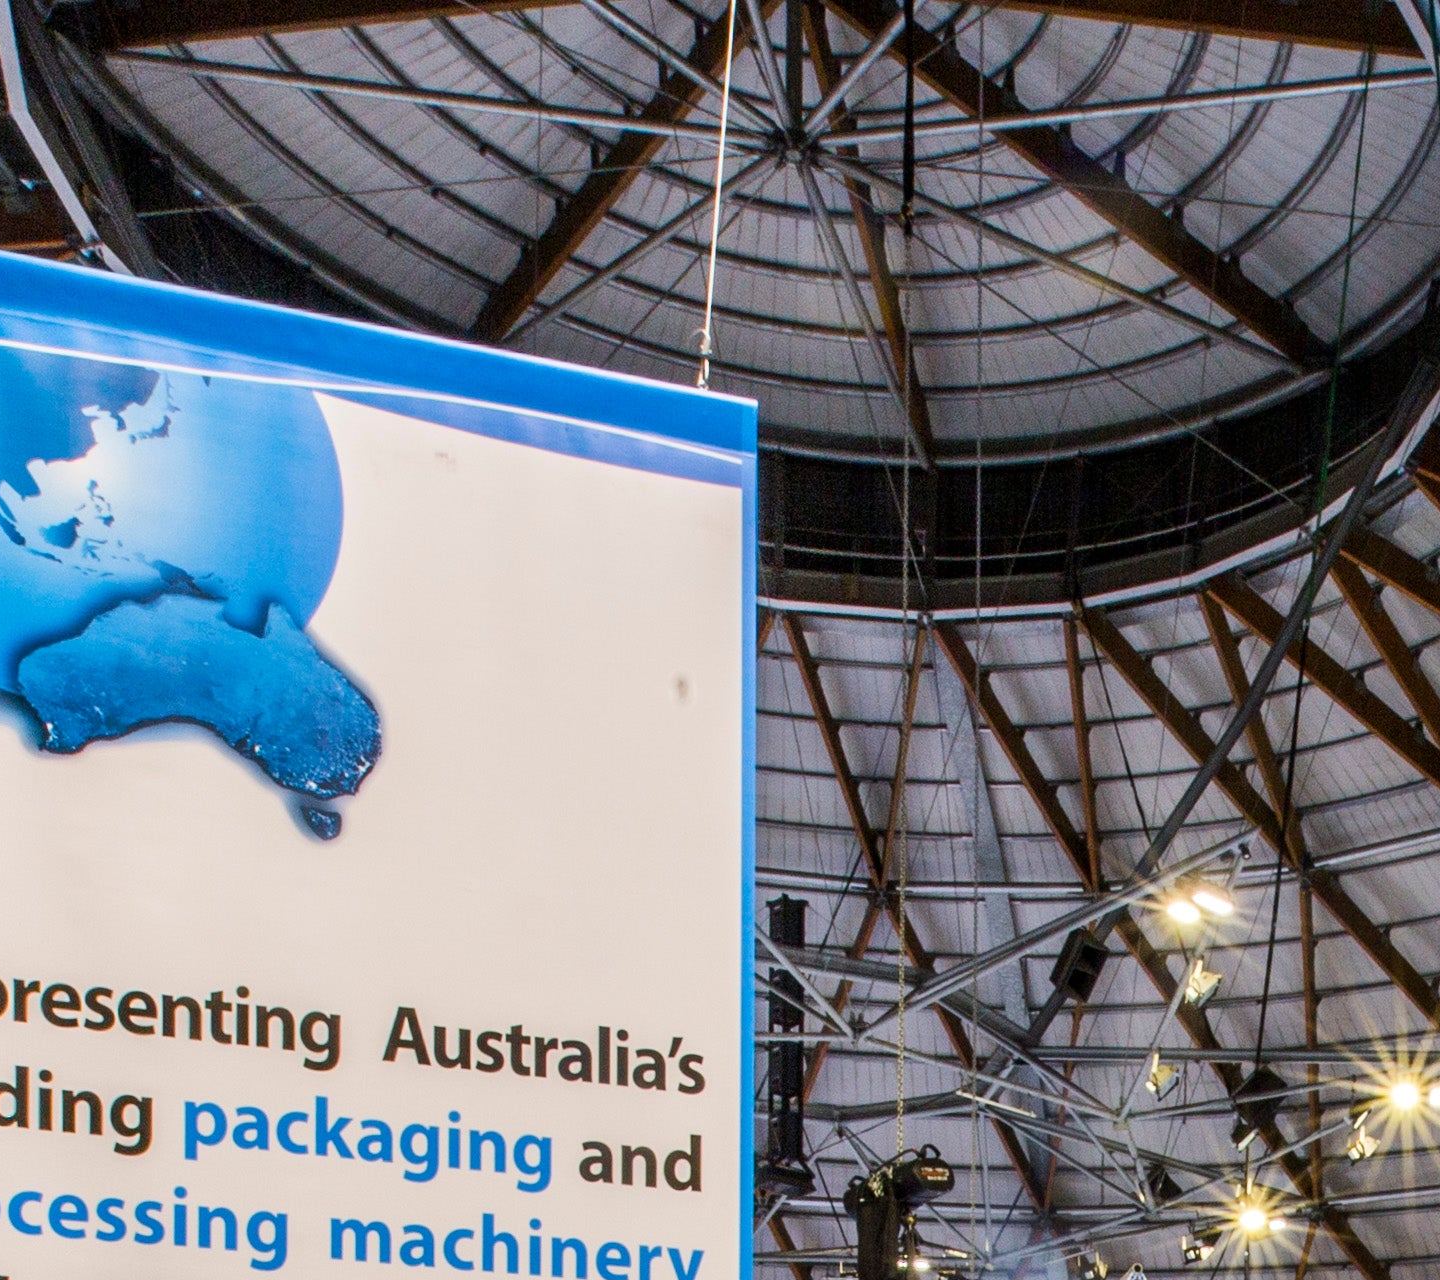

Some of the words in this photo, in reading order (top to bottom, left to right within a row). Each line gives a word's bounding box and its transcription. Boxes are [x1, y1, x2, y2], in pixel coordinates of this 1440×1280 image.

[383, 1006, 705, 1097] Australia's
[183, 1097, 553, 1193] packaging
[579, 1136, 703, 1192] and
